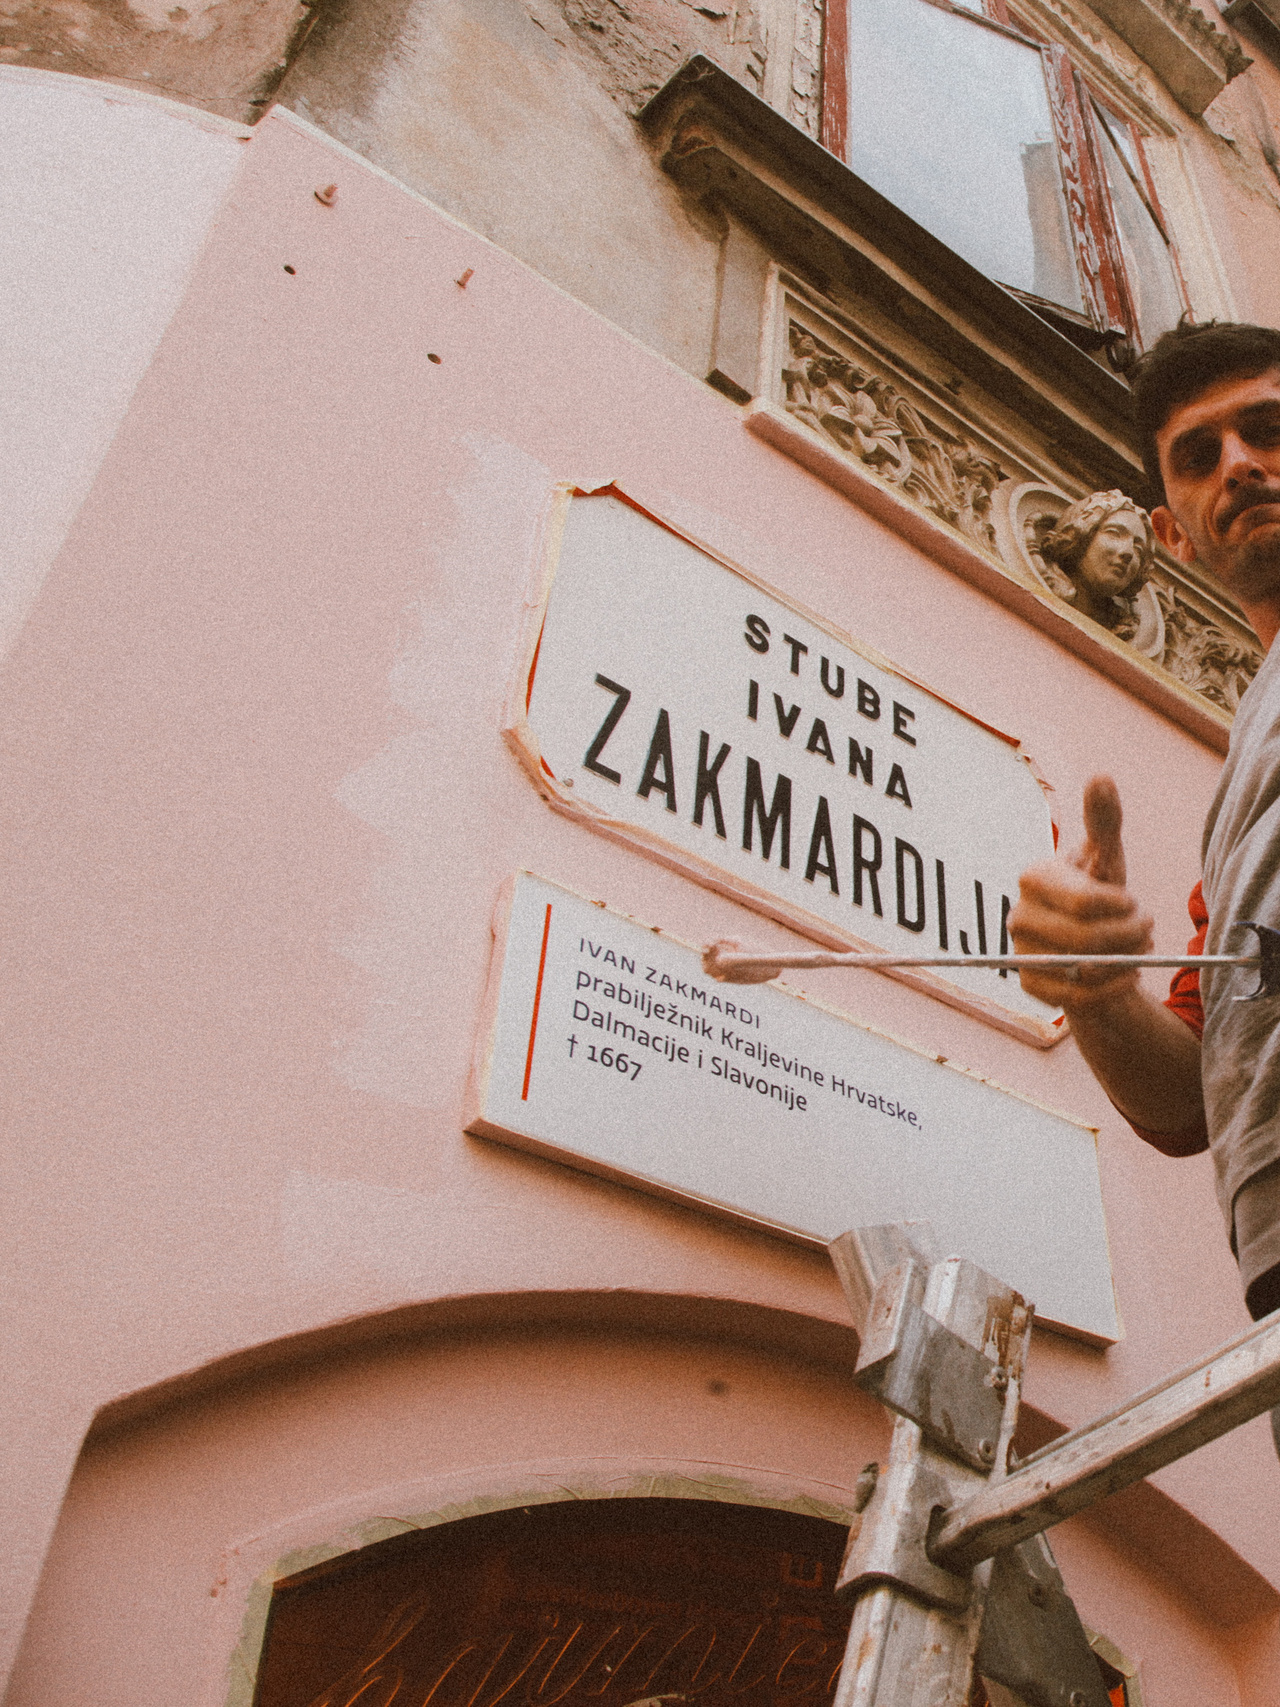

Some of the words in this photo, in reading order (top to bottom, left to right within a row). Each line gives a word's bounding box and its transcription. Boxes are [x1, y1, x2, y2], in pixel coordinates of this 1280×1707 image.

[744, 614, 917, 748] STUBE
[747, 679, 912, 810] IVANA
[579, 938, 635, 974] IVAN
[645, 966, 760, 1029] ZAKMARDI
[573, 999, 690, 1063] Dalmacije
[698, 1049, 703, 1069] i
[711, 1056, 808, 1112] Slavonije
[576, 970, 713, 1041] prabilježnik
[721, 1027, 825, 1087] Kraljevine
[832, 1075, 923, 1131] Hrvatske,
[587, 1045, 642, 1081] 1667
